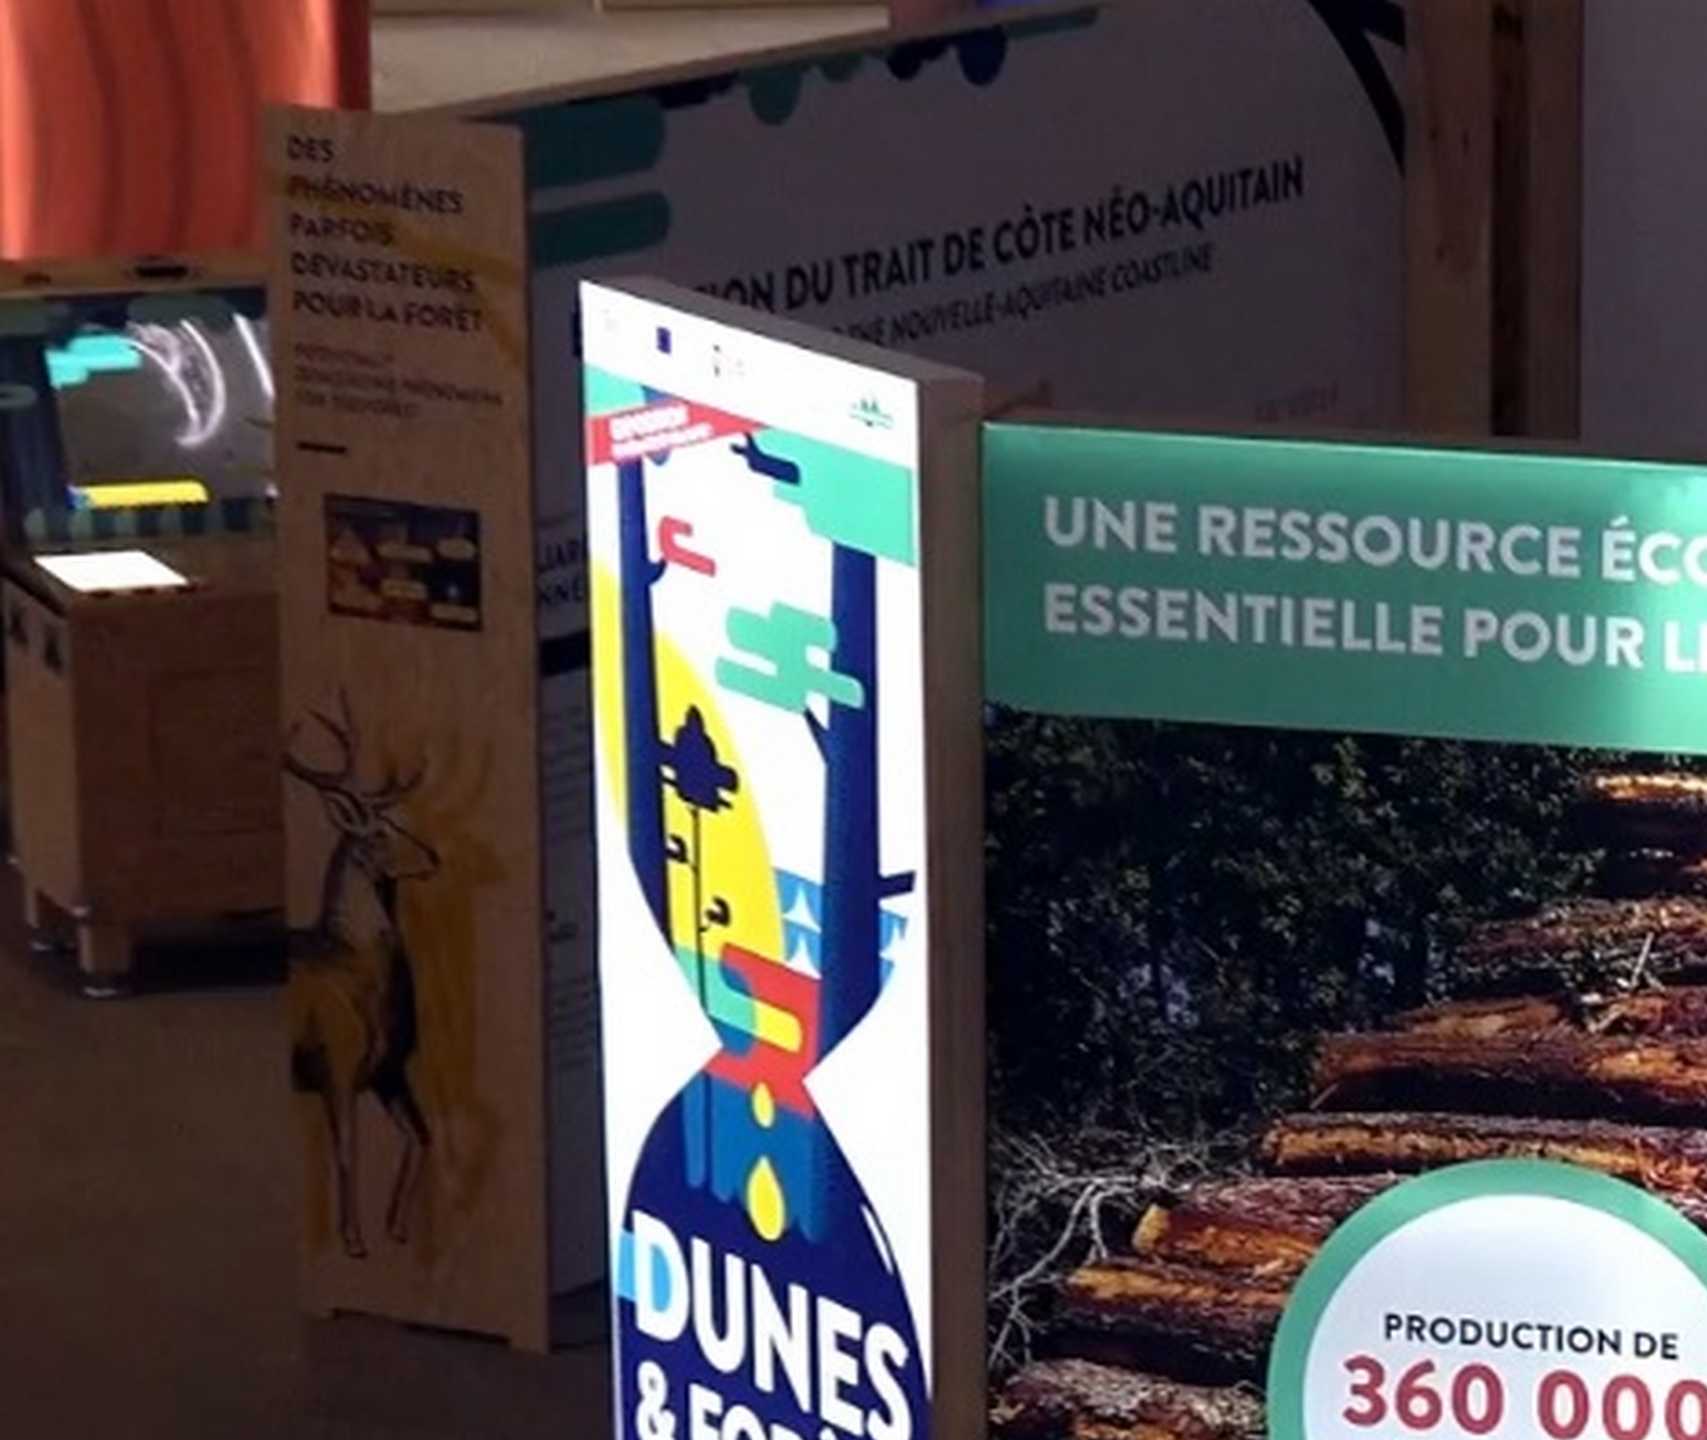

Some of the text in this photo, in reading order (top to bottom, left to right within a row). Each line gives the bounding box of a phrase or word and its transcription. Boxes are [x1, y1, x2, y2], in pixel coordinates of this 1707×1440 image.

[287, 134, 335, 164] DES
[289, 212, 394, 247] PARFOIS
[784, 260, 834, 311] DU
[842, 237, 937, 298] TRAIT
[943, 226, 985, 277] DE
[993, 203, 1076, 263] CÔTE
[1083, 153, 1306, 246] NÉO-AQUITAIN
[293, 291, 361, 319] POUR
[366, 300, 398, 325] LA
[1045, 496, 1179, 554] UNE
[1197, 505, 1582, 580] RESSOURCE
[1044, 582, 1445, 657] ESSENTIELLE
[1463, 608, 1644, 669] POUR
[1384, 1313, 1680, 1361] PRODUCTION DE
[1342, 1354, 1502, 1435] 360
